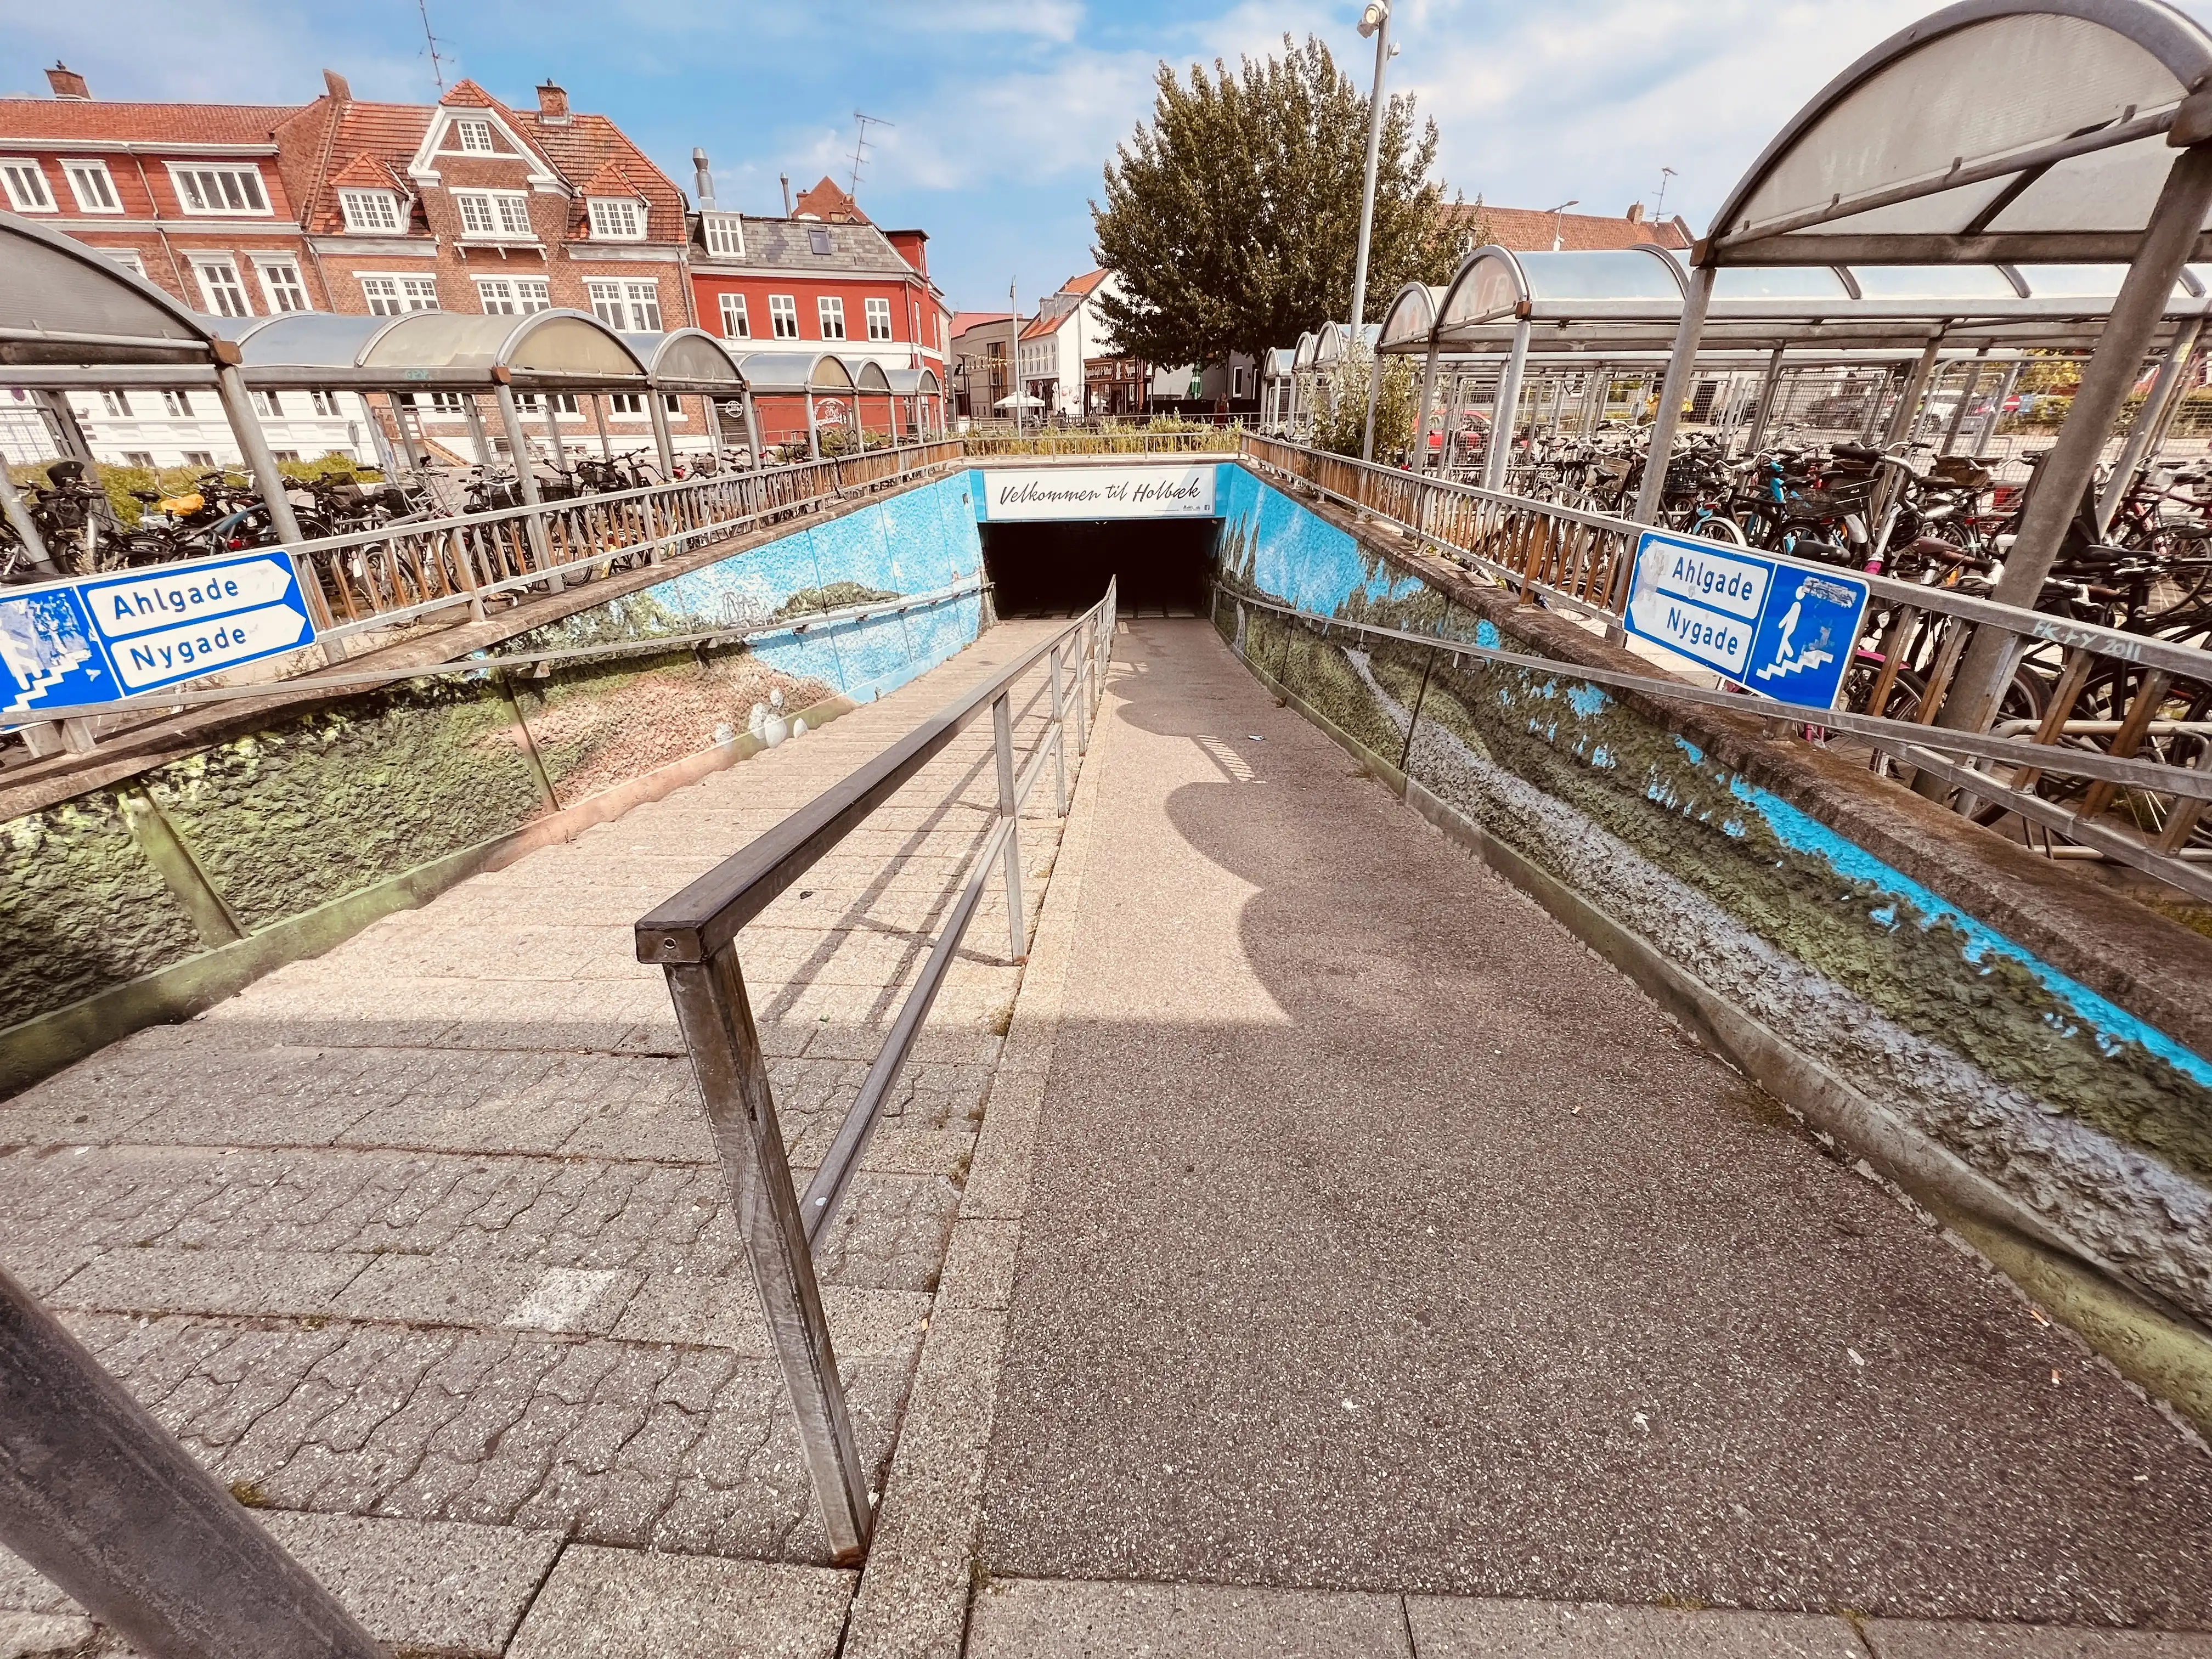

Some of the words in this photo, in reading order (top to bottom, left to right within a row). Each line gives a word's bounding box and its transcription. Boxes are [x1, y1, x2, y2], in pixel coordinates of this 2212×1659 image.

[1000, 481, 1102, 505] Velkommen
[1105, 481, 1129, 500] til
[1132, 477, 1201, 502] Holbæk
[114, 578, 239, 620] Ahlgade
[1672, 556, 1753, 601] Ahlgade
[129, 625, 247, 671] Nygade
[1666, 606, 1738, 656] Nygade
[2100, 638, 2142, 662] 2011
